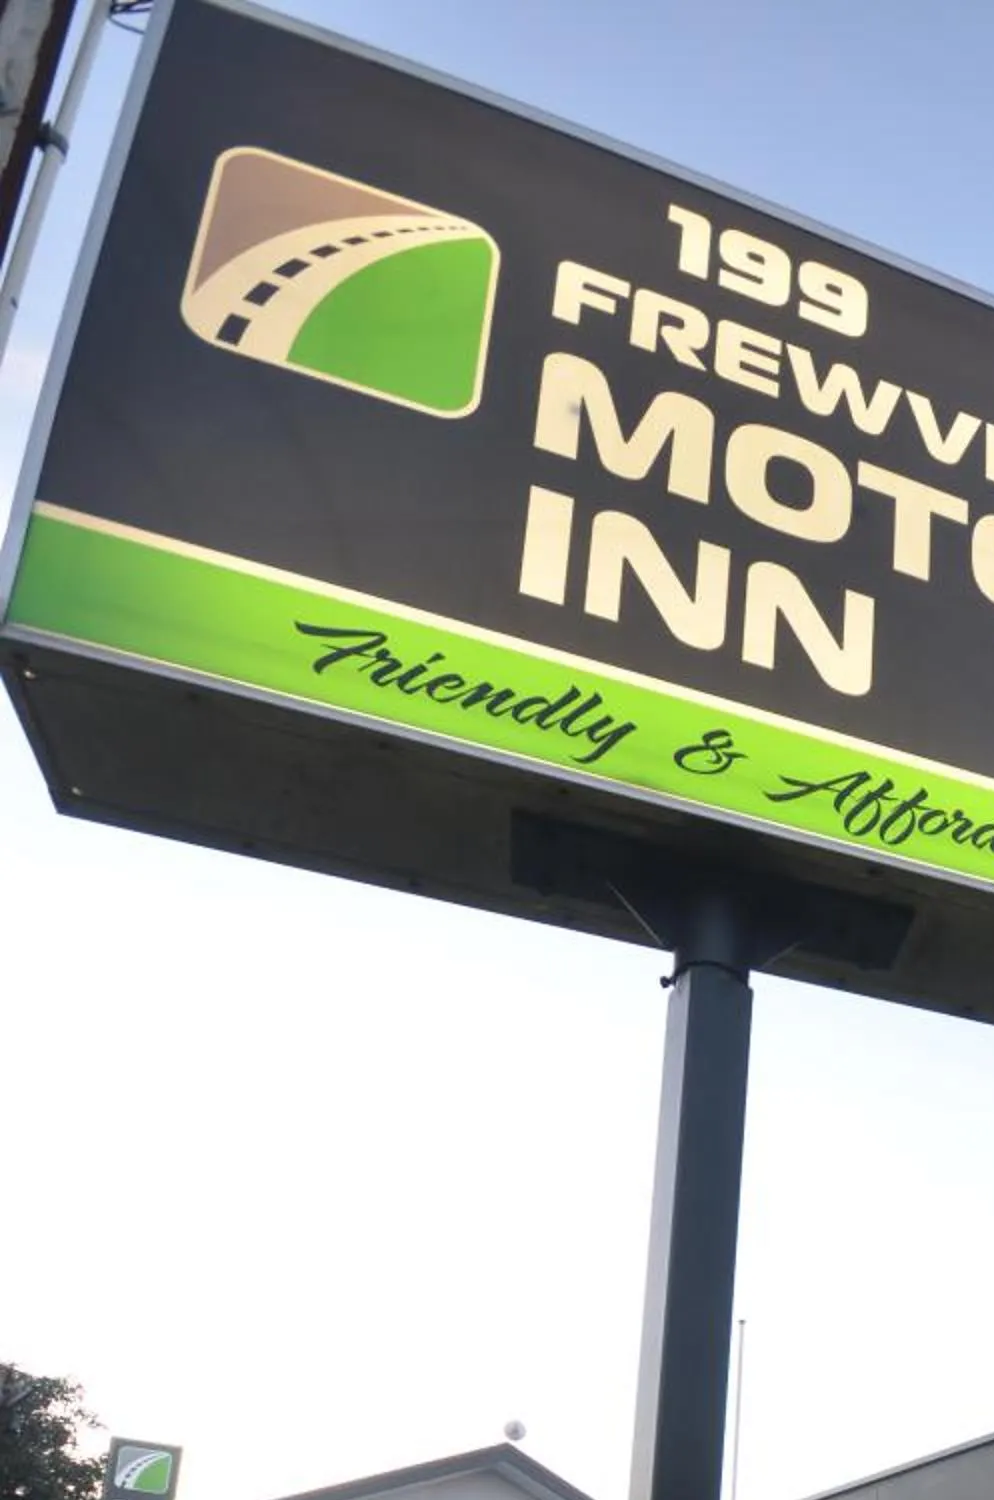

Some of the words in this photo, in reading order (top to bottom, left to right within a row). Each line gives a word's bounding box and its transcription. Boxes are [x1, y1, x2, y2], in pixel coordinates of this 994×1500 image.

[666, 203, 869, 338] 199
[518, 484, 876, 698] INN
[295, 620, 636, 766] Friendly
[673, 728, 747, 777] &
